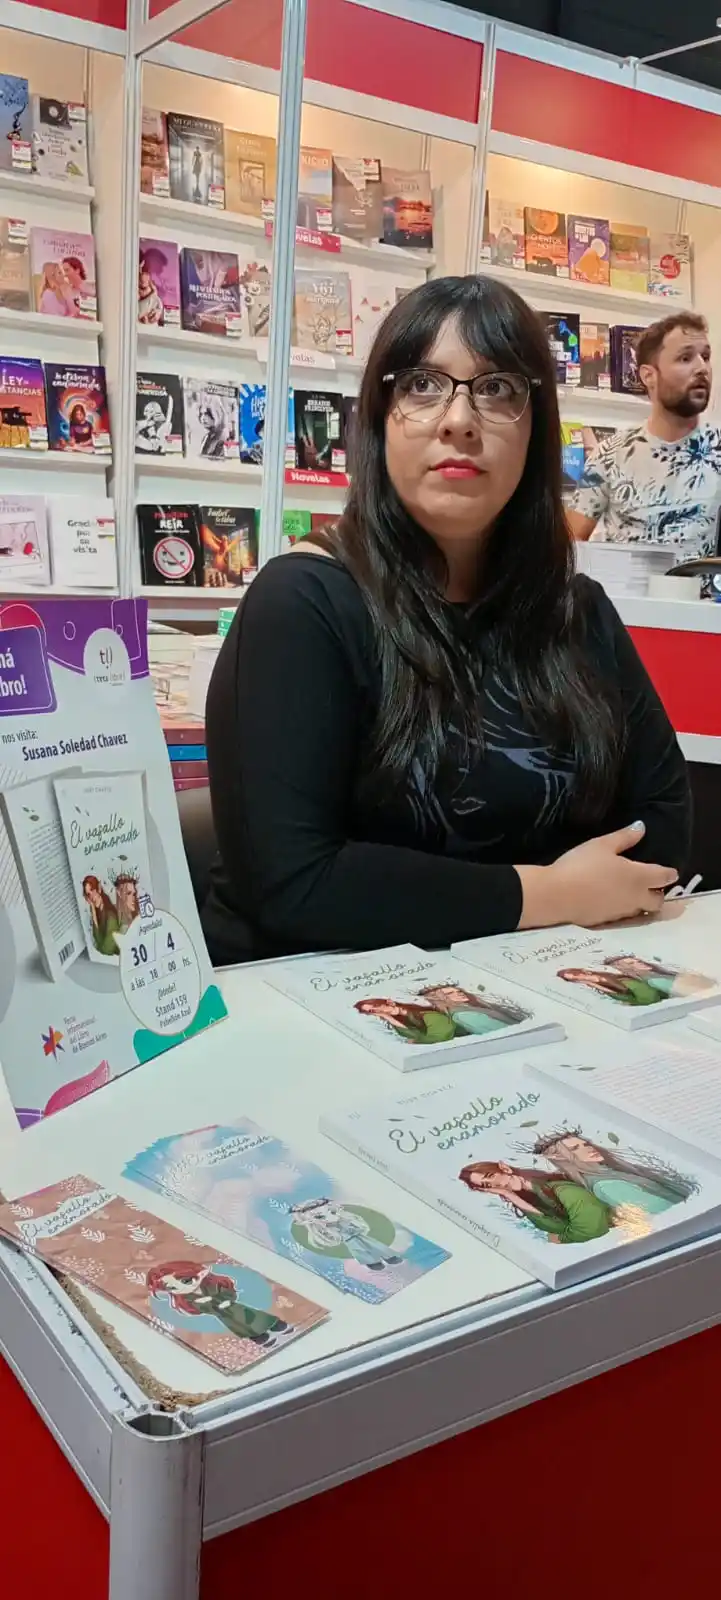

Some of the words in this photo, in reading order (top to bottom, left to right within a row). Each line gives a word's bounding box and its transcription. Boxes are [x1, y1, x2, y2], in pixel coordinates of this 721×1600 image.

[2, 376, 23, 385] LEY
[291, 472, 330, 484] Novelas
[0, 674, 27, 696] bro!
[2, 734, 15, 744] nos
[16, 729, 38, 741] visita:
[22, 745, 58, 761] Susana
[59, 736, 97, 755] Soledad
[98, 733, 128, 748] Chavez
[84, 820, 140, 856] enamorado
[131, 944, 148, 967] 30
[167, 932, 175, 950] 4
[168, 960, 176, 972] 00
[155, 1000, 175, 1017] Stand
[175, 994, 188, 1006] 159
[181, 1006, 191, 1019] Azul
[389, 1129, 426, 1153] El
[428, 1097, 503, 1137] vasallo
[437, 1092, 540, 1150] enamorado
